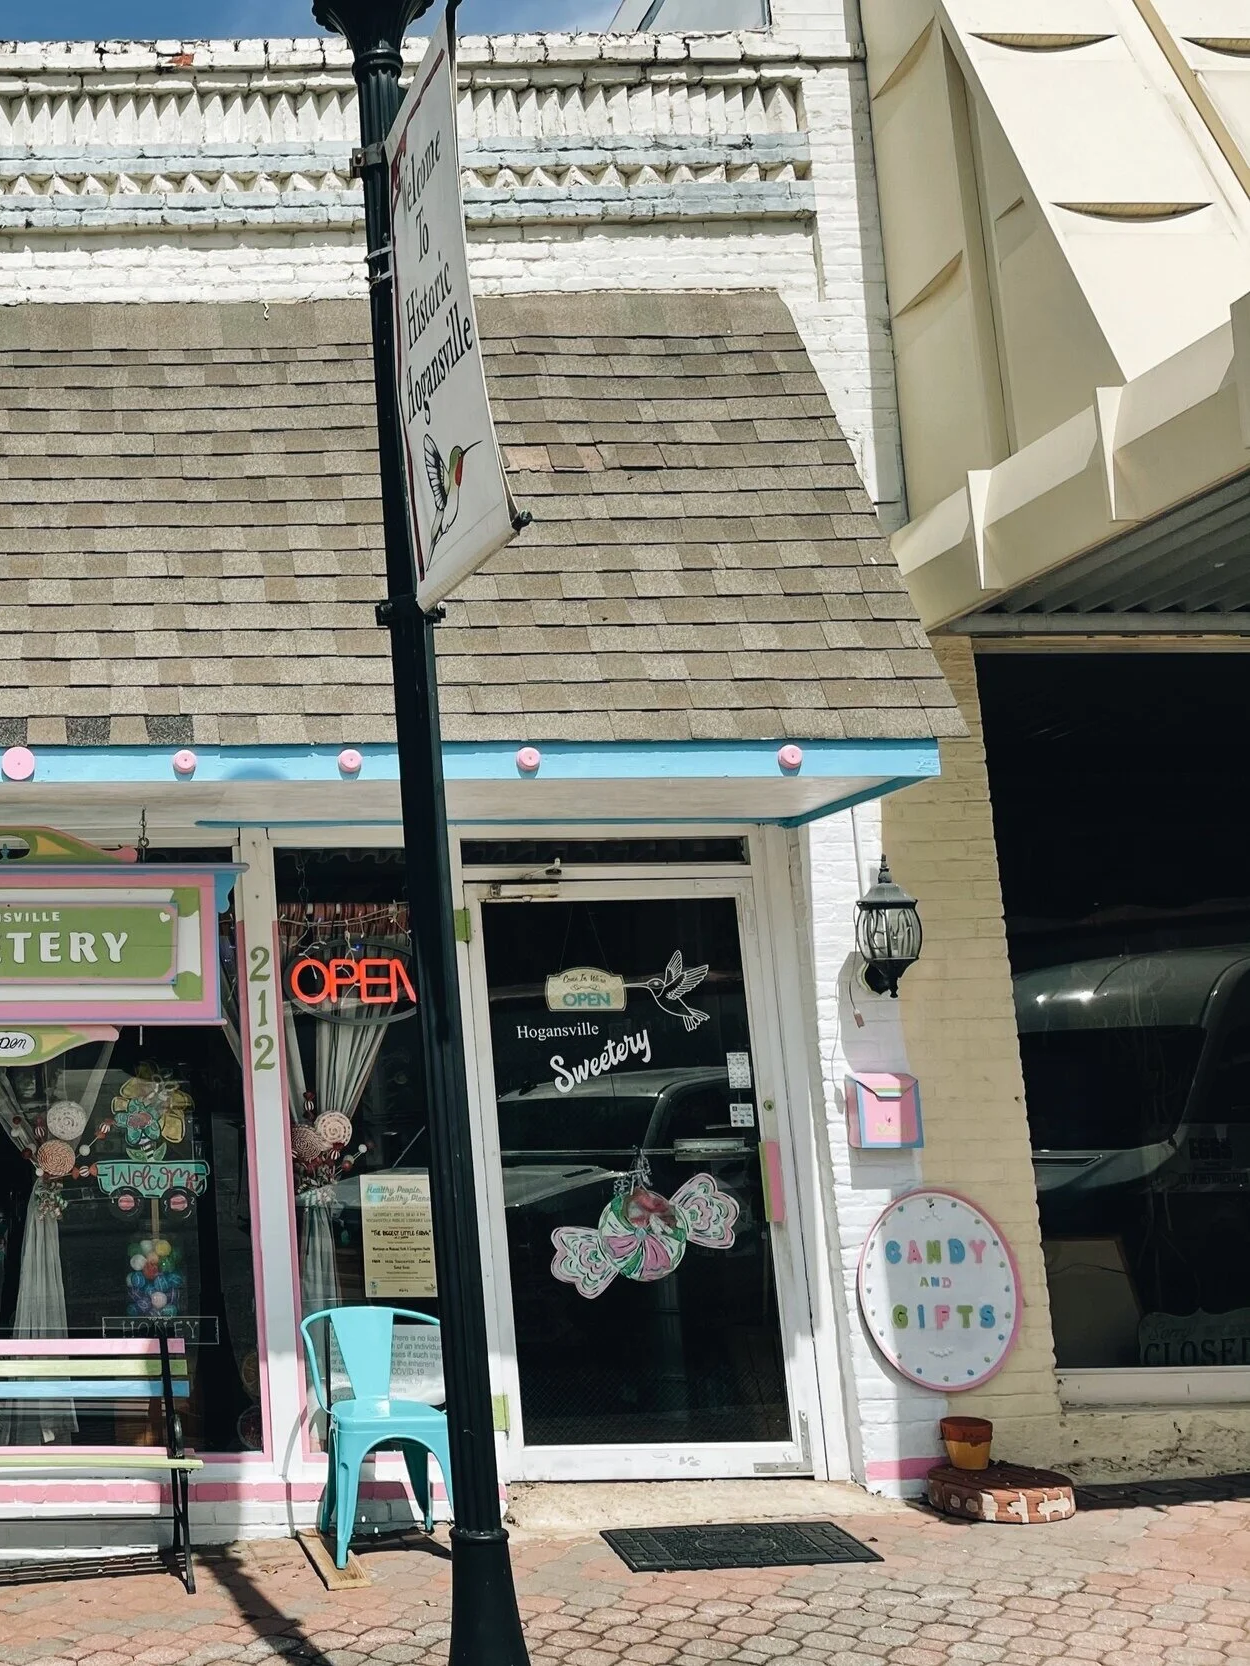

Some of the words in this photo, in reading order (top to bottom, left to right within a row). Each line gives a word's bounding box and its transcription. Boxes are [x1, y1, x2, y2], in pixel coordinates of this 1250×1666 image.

[396, 130, 441, 222] Welcome
[416, 205, 429, 262] To
[406, 250, 452, 352] Historic
[406, 301, 473, 425] Hogansville
[291, 958, 417, 1005] OPEN
[249, 946, 276, 1071] 212
[562, 992, 612, 1007] OPEN
[516, 1022, 600, 1042] Hogansville
[549, 1029, 652, 1094] Sweetery
[105, 1164, 199, 1192] Welcome
[885, 1238, 987, 1264] CANDY
[919, 1276, 952, 1289] AND
[122, 1320, 199, 1339] HONEY
[892, 1304, 996, 1330] GIFTS
[412, 1351, 429, 1359] such
[391, 1367, 425, 1376] COVID-19
